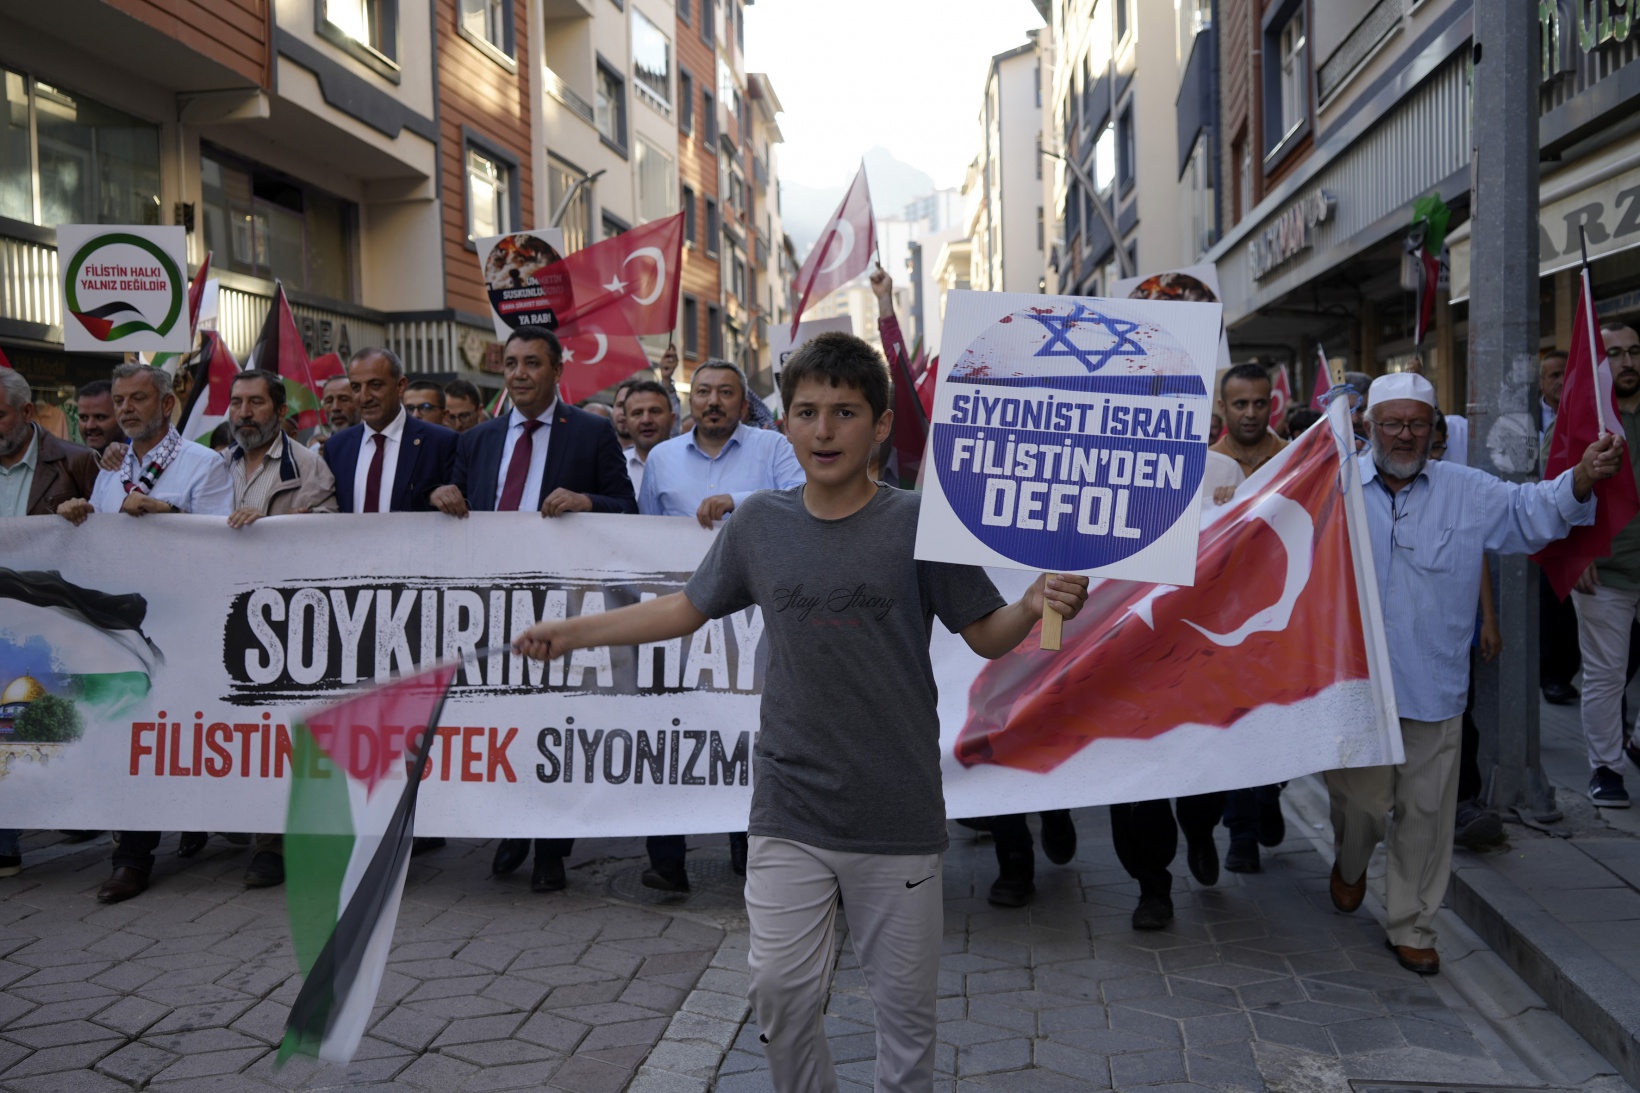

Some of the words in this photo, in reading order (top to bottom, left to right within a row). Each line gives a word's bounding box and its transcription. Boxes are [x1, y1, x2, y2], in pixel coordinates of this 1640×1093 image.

[81, 279, 118, 291] YALNIZ
[120, 278, 167, 291] DEĞİLDİR
[85, 264, 127, 277] FİLİSTİN
[130, 266, 161, 278] HALKI
[518, 314, 530, 326] YA
[531, 312, 552, 325] RAB!
[950, 389, 1094, 433] SİYONİST
[1100, 398, 1202, 441] İSRAİL
[951, 431, 1185, 490] FİLİSTİN'DEN
[981, 477, 1141, 539] DEFOL
[772, 583, 821, 622] Stay
[821, 583, 896, 622] Strong
[244, 588, 613, 687] SOYKIRIMA
[129, 710, 333, 779] FİLİSTİNE
[350, 724, 519, 783] DESTEK
[536, 716, 761, 787] SİYONİZM
